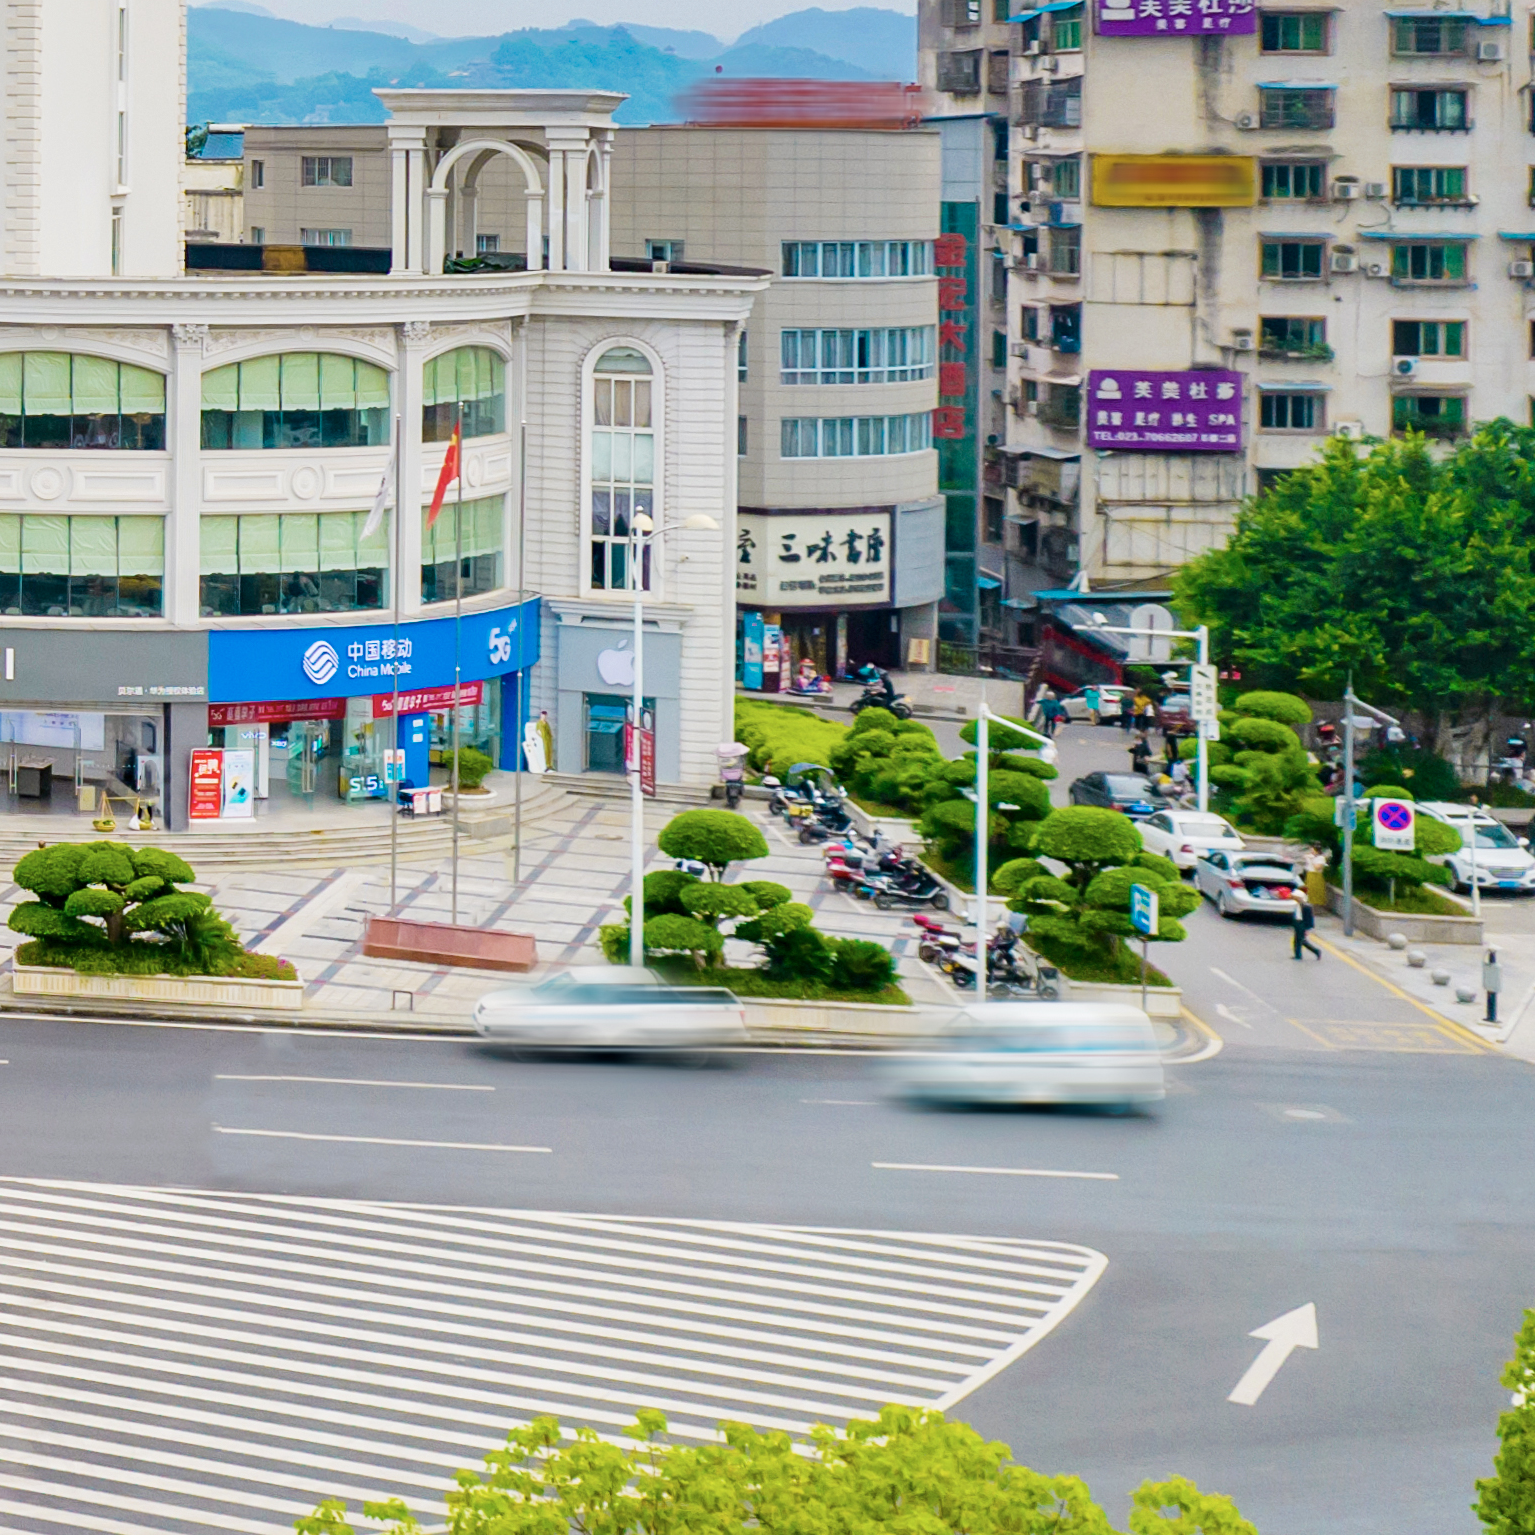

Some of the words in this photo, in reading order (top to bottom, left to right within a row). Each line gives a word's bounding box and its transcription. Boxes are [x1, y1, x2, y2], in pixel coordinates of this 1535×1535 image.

[1208, 413, 1236, 426] SPA
[347, 637, 412, 662] 中国移动
[347, 665, 379, 678] China
[380, 663, 412, 677] Mobile
[241, 730, 267, 740] vivo
